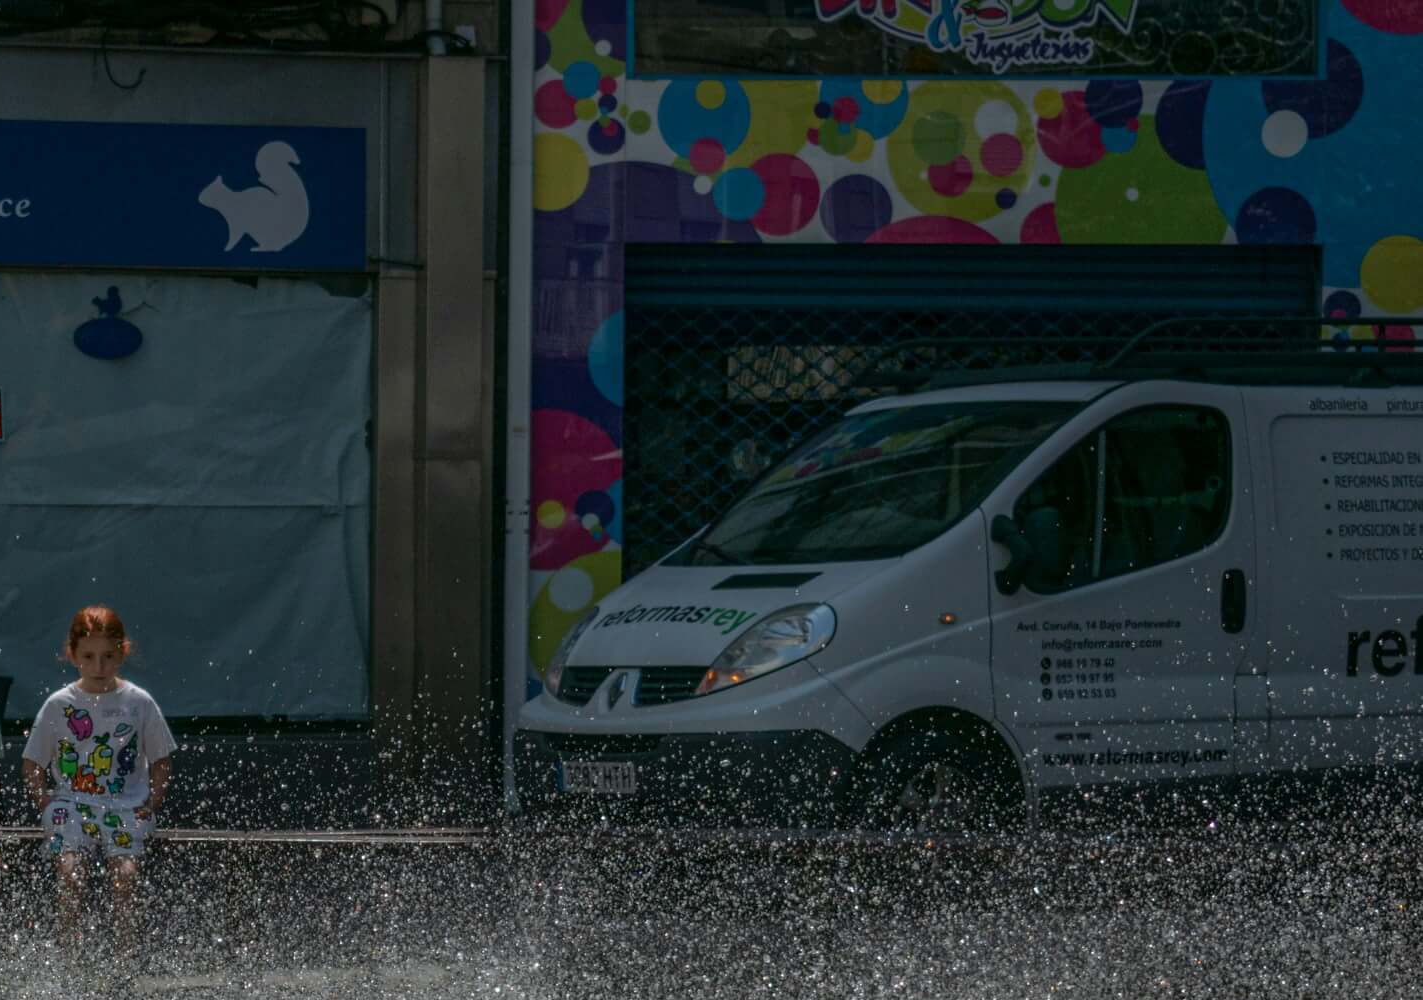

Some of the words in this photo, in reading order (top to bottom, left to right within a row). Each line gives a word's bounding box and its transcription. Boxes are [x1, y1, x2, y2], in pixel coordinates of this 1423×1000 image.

[1332, 452, 1404, 464] ESPECIALIDAD
[1407, 452, 1422, 464] EN
[1334, 475, 1390, 488] REFORMAS
[1338, 523, 1400, 537] EXPOSICION
[1403, 523, 1417, 537] DE
[1340, 547, 1399, 561] PROYECTOS
[1402, 548, 1409, 561] Y
[593, 603, 757, 635] reformasrey
[1017, 621, 1040, 631] Avd.
[1124, 618, 1182, 630] Pontevedra
[1042, 747, 1228, 767] www.reformasrey.com
